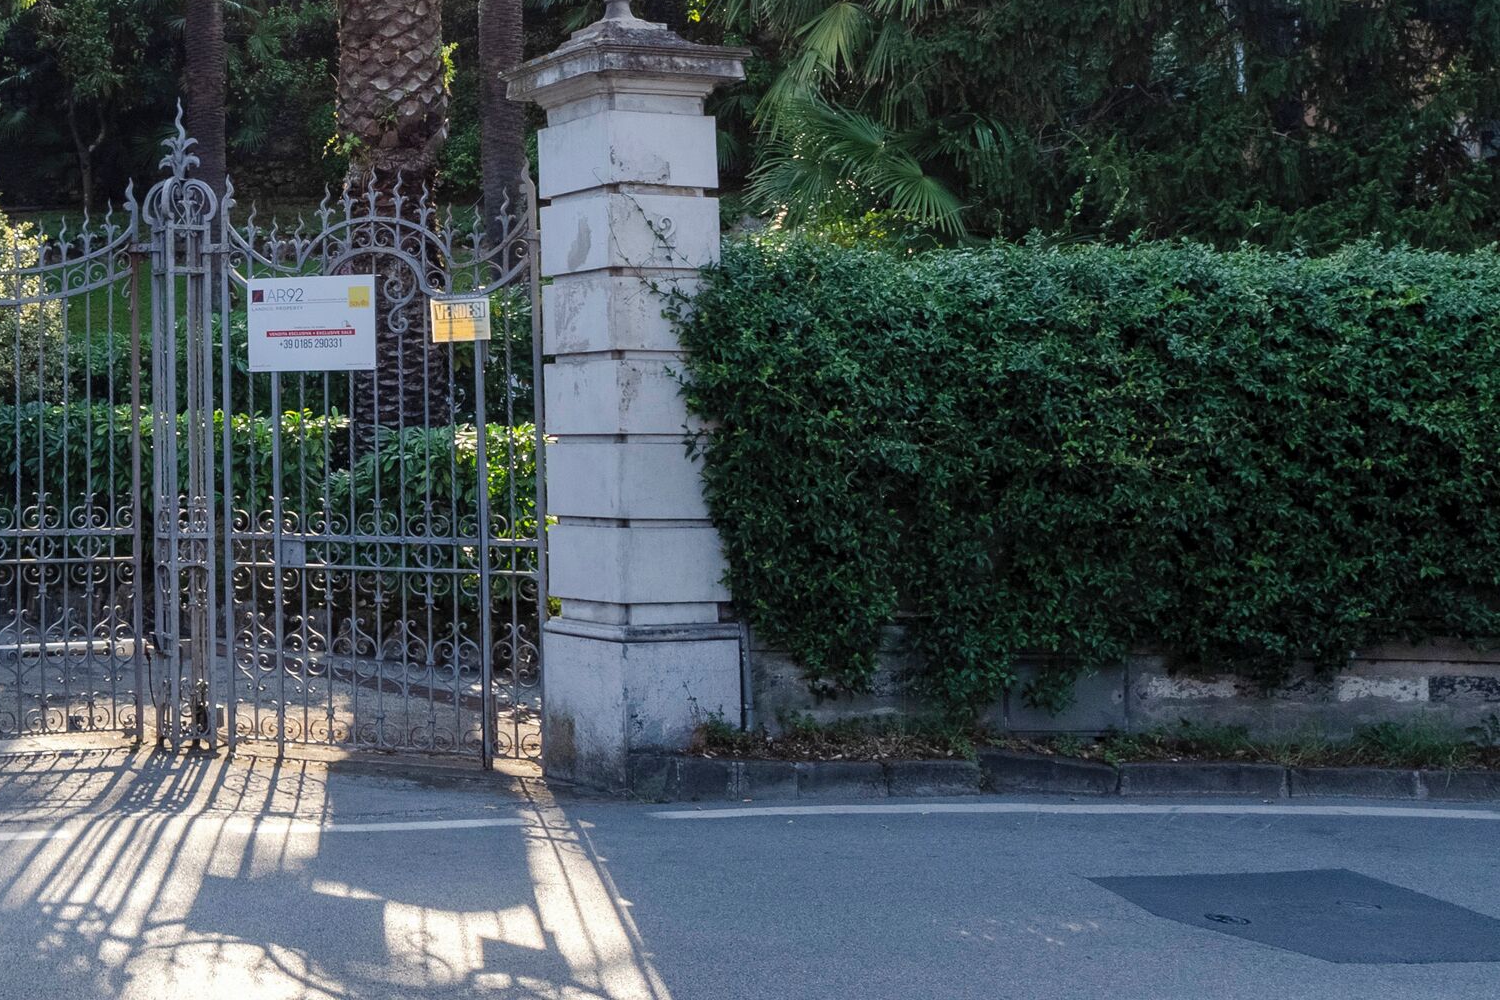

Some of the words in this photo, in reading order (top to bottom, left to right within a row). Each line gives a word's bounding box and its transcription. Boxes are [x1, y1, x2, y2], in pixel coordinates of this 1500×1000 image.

[657, 216, 677, 248] 2
[266, 287, 304, 303] AR92
[434, 302, 485, 320] VENDESI
[280, 339, 293, 349] +39
[294, 339, 313, 349] 0185
[314, 338, 342, 348] 290331
